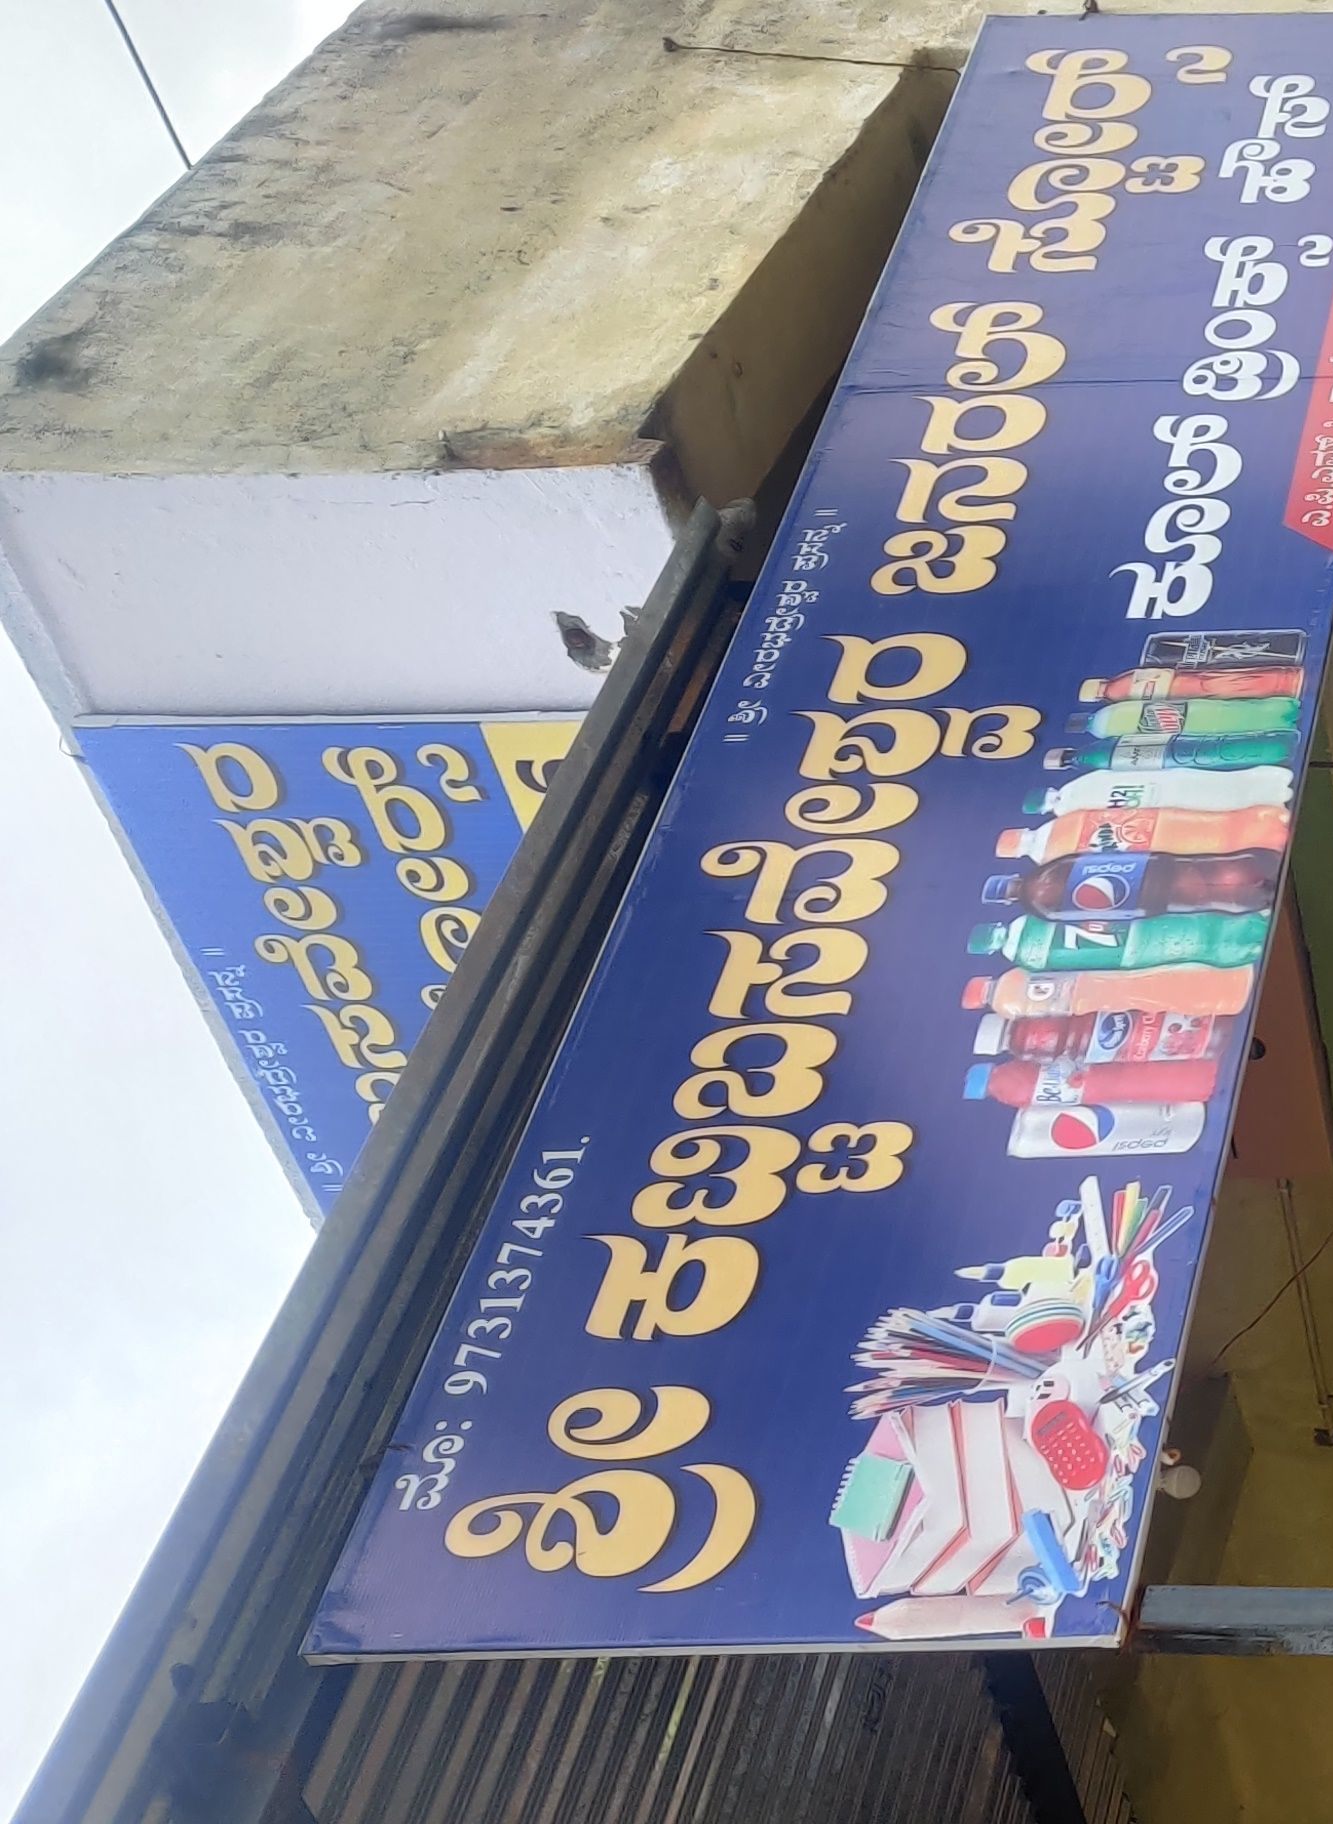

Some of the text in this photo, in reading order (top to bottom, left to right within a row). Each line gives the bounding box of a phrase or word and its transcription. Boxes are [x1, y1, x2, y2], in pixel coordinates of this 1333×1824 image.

[1108, 414, 1243, 620] ಕೂಲ್
[1217, 74, 1331, 205] ಹೌಸ್
[869, 300, 1066, 596] ಜನರಲ್
[791, 522, 847, 571] ಪ್ರಸನ್ನ
[727, 700, 768, 725] ಶ್ರೀ
[743, 580, 819, 689] ವೀರಭದ್ರೇಶ್ವರ
[1080, 862, 1138, 876] pepsi
[580, 631, 1042, 1342] ಕಟ್ಟಿಬಸವೇಶ್ವರ
[444, 1385, 757, 1593] ಶ್ರೀ
